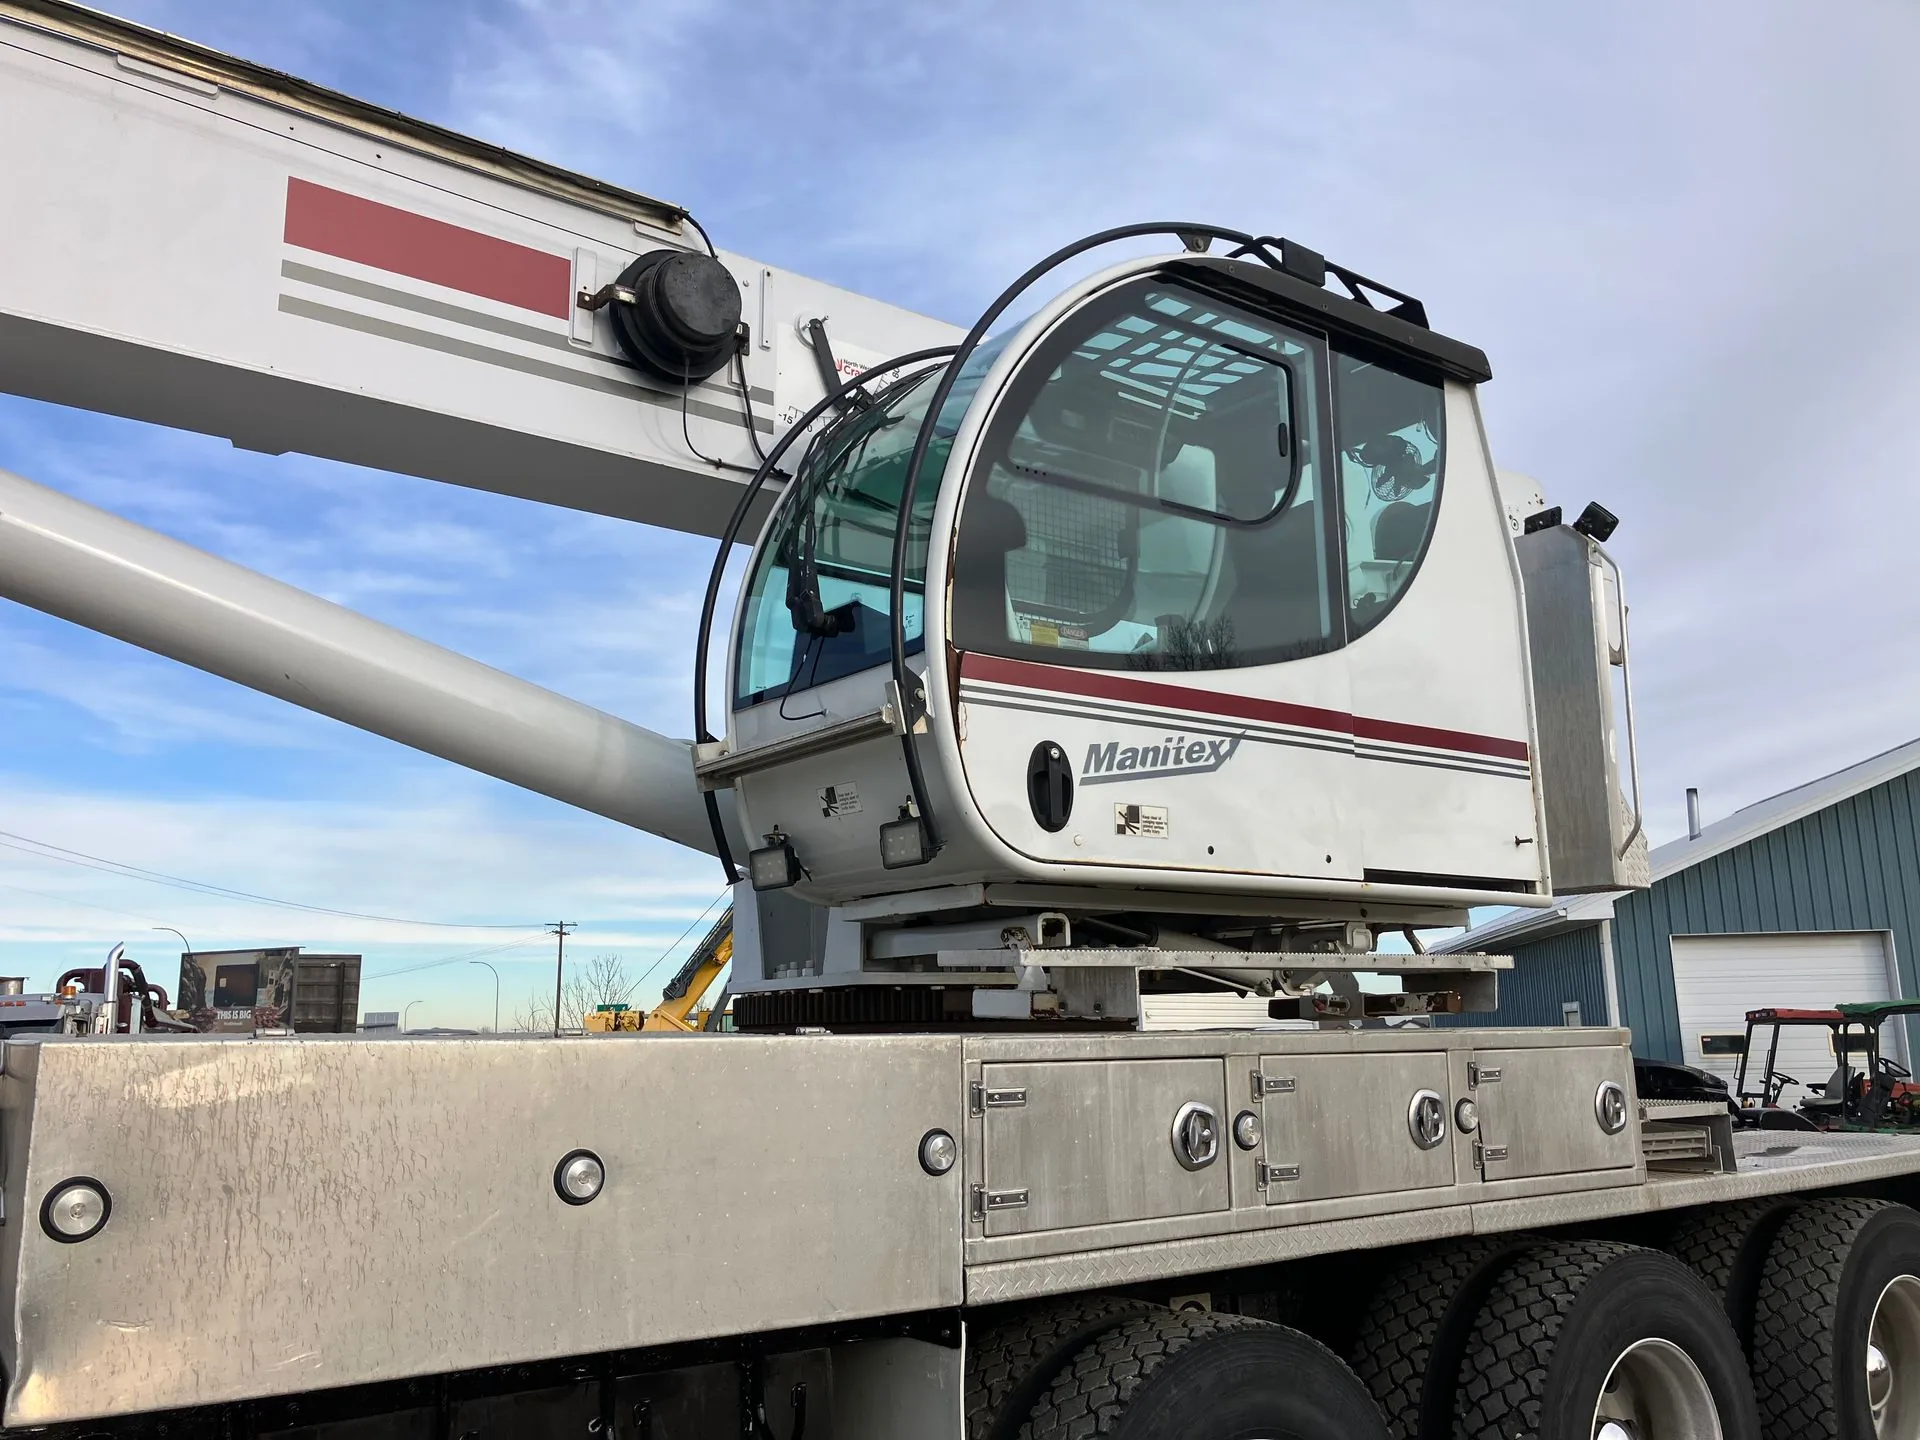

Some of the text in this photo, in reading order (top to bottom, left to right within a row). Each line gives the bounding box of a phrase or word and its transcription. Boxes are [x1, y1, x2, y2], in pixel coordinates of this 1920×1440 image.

[843, 359, 859, 368] North
[778, 413, 794, 425] -15
[1080, 732, 1240, 776] Manitex
[216, 1010, 252, 1020] THIS IS BIG
